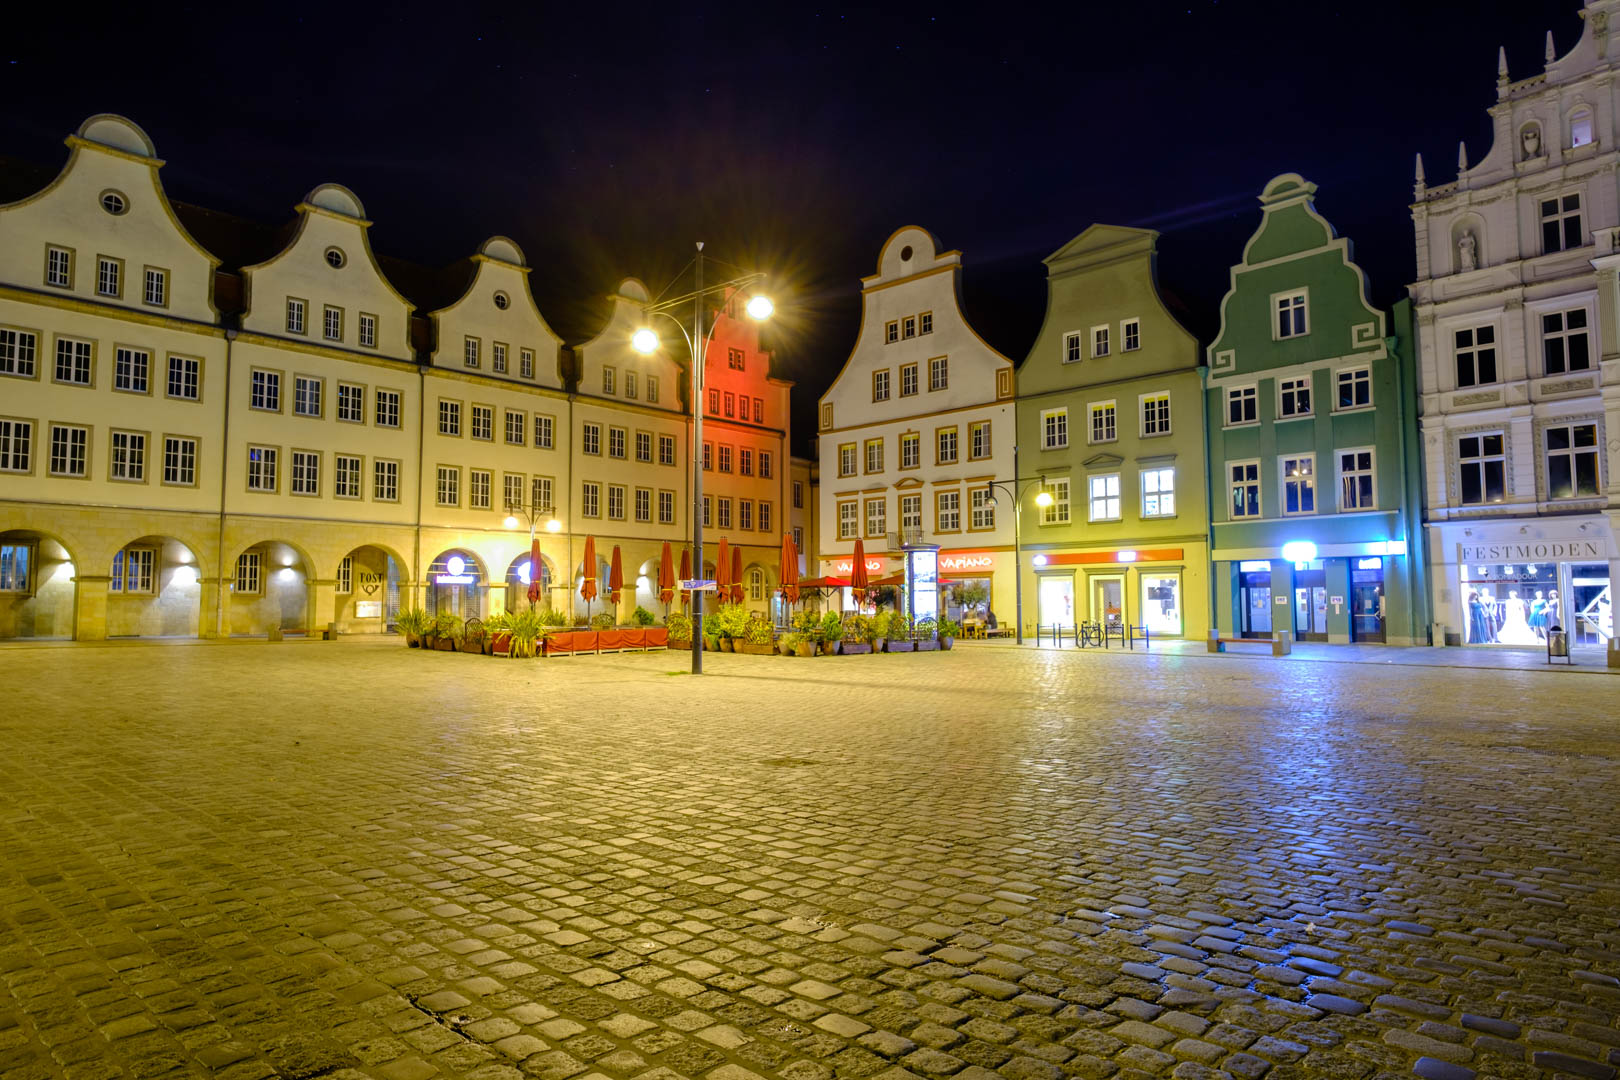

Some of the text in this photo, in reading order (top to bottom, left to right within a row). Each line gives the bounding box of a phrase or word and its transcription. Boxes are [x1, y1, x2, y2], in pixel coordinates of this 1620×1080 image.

[1462, 542, 1598, 560] FESTMODEN
[837, 560, 881, 573] VANO
[360, 572, 384, 584] POST
